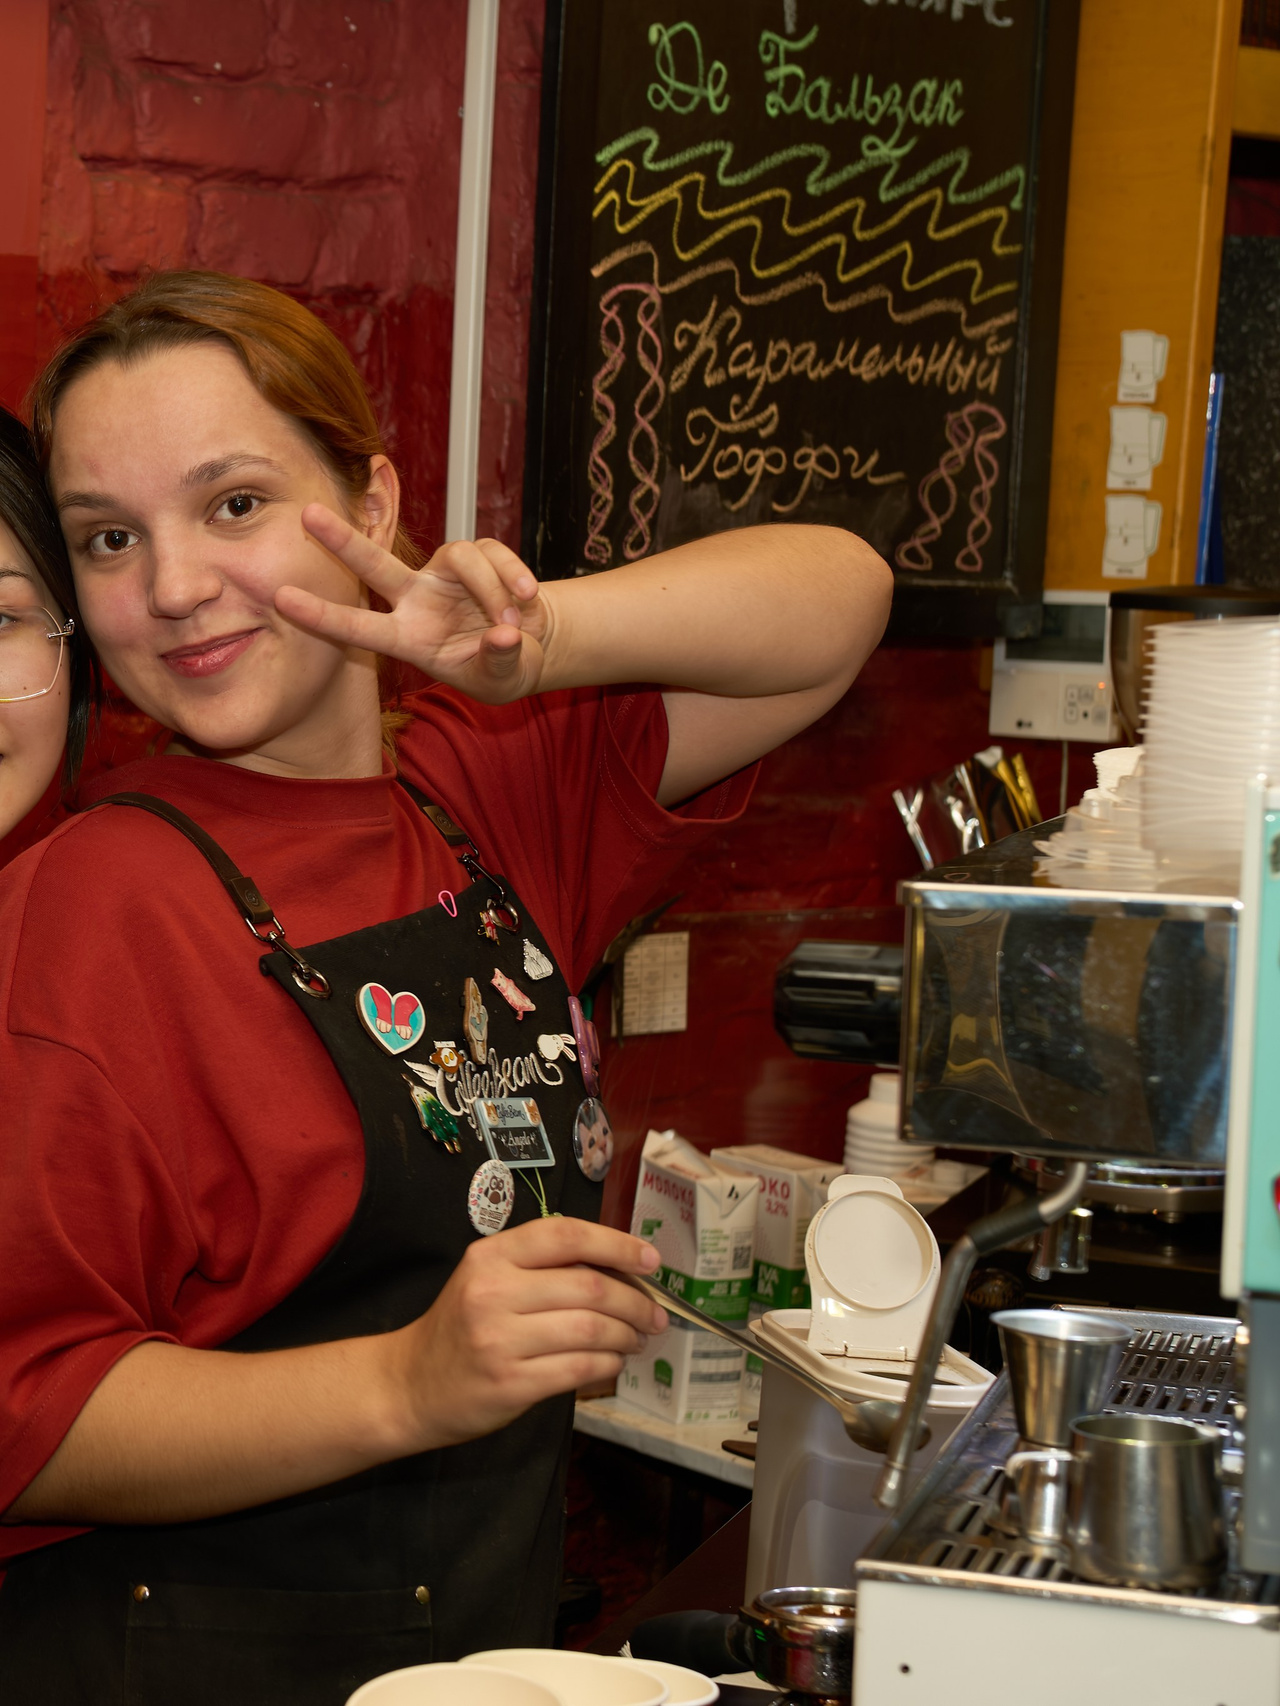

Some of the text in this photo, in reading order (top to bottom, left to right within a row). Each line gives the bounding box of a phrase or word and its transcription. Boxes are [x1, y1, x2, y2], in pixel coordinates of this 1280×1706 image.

[647, 21, 964, 158] Де Бальзак
[671, 296, 1013, 420] Карамельный
[643, 1170, 695, 1209] МОЛОКО
